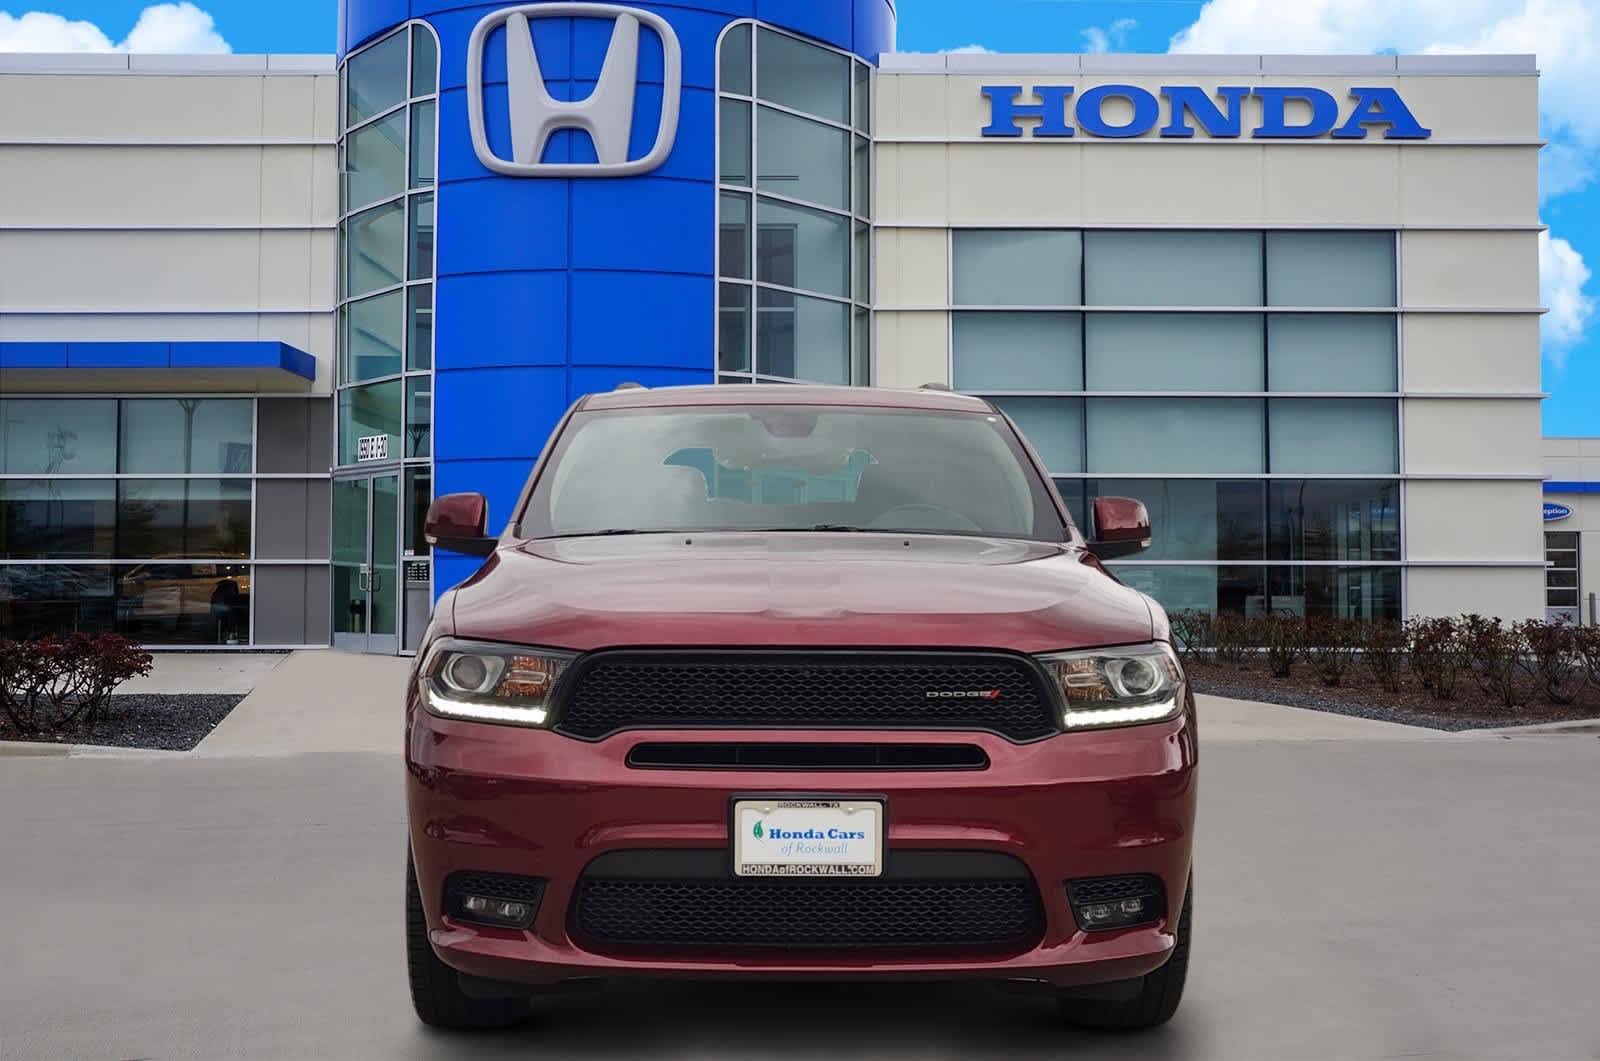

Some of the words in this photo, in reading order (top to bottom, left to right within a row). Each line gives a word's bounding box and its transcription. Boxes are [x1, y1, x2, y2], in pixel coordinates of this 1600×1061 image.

[980, 84, 1432, 139] HONDA
[769, 828, 825, 840] Honda
[828, 828, 865, 840] Cars
[781, 842, 794, 857] of
[796, 842, 849, 855] Rockwall
